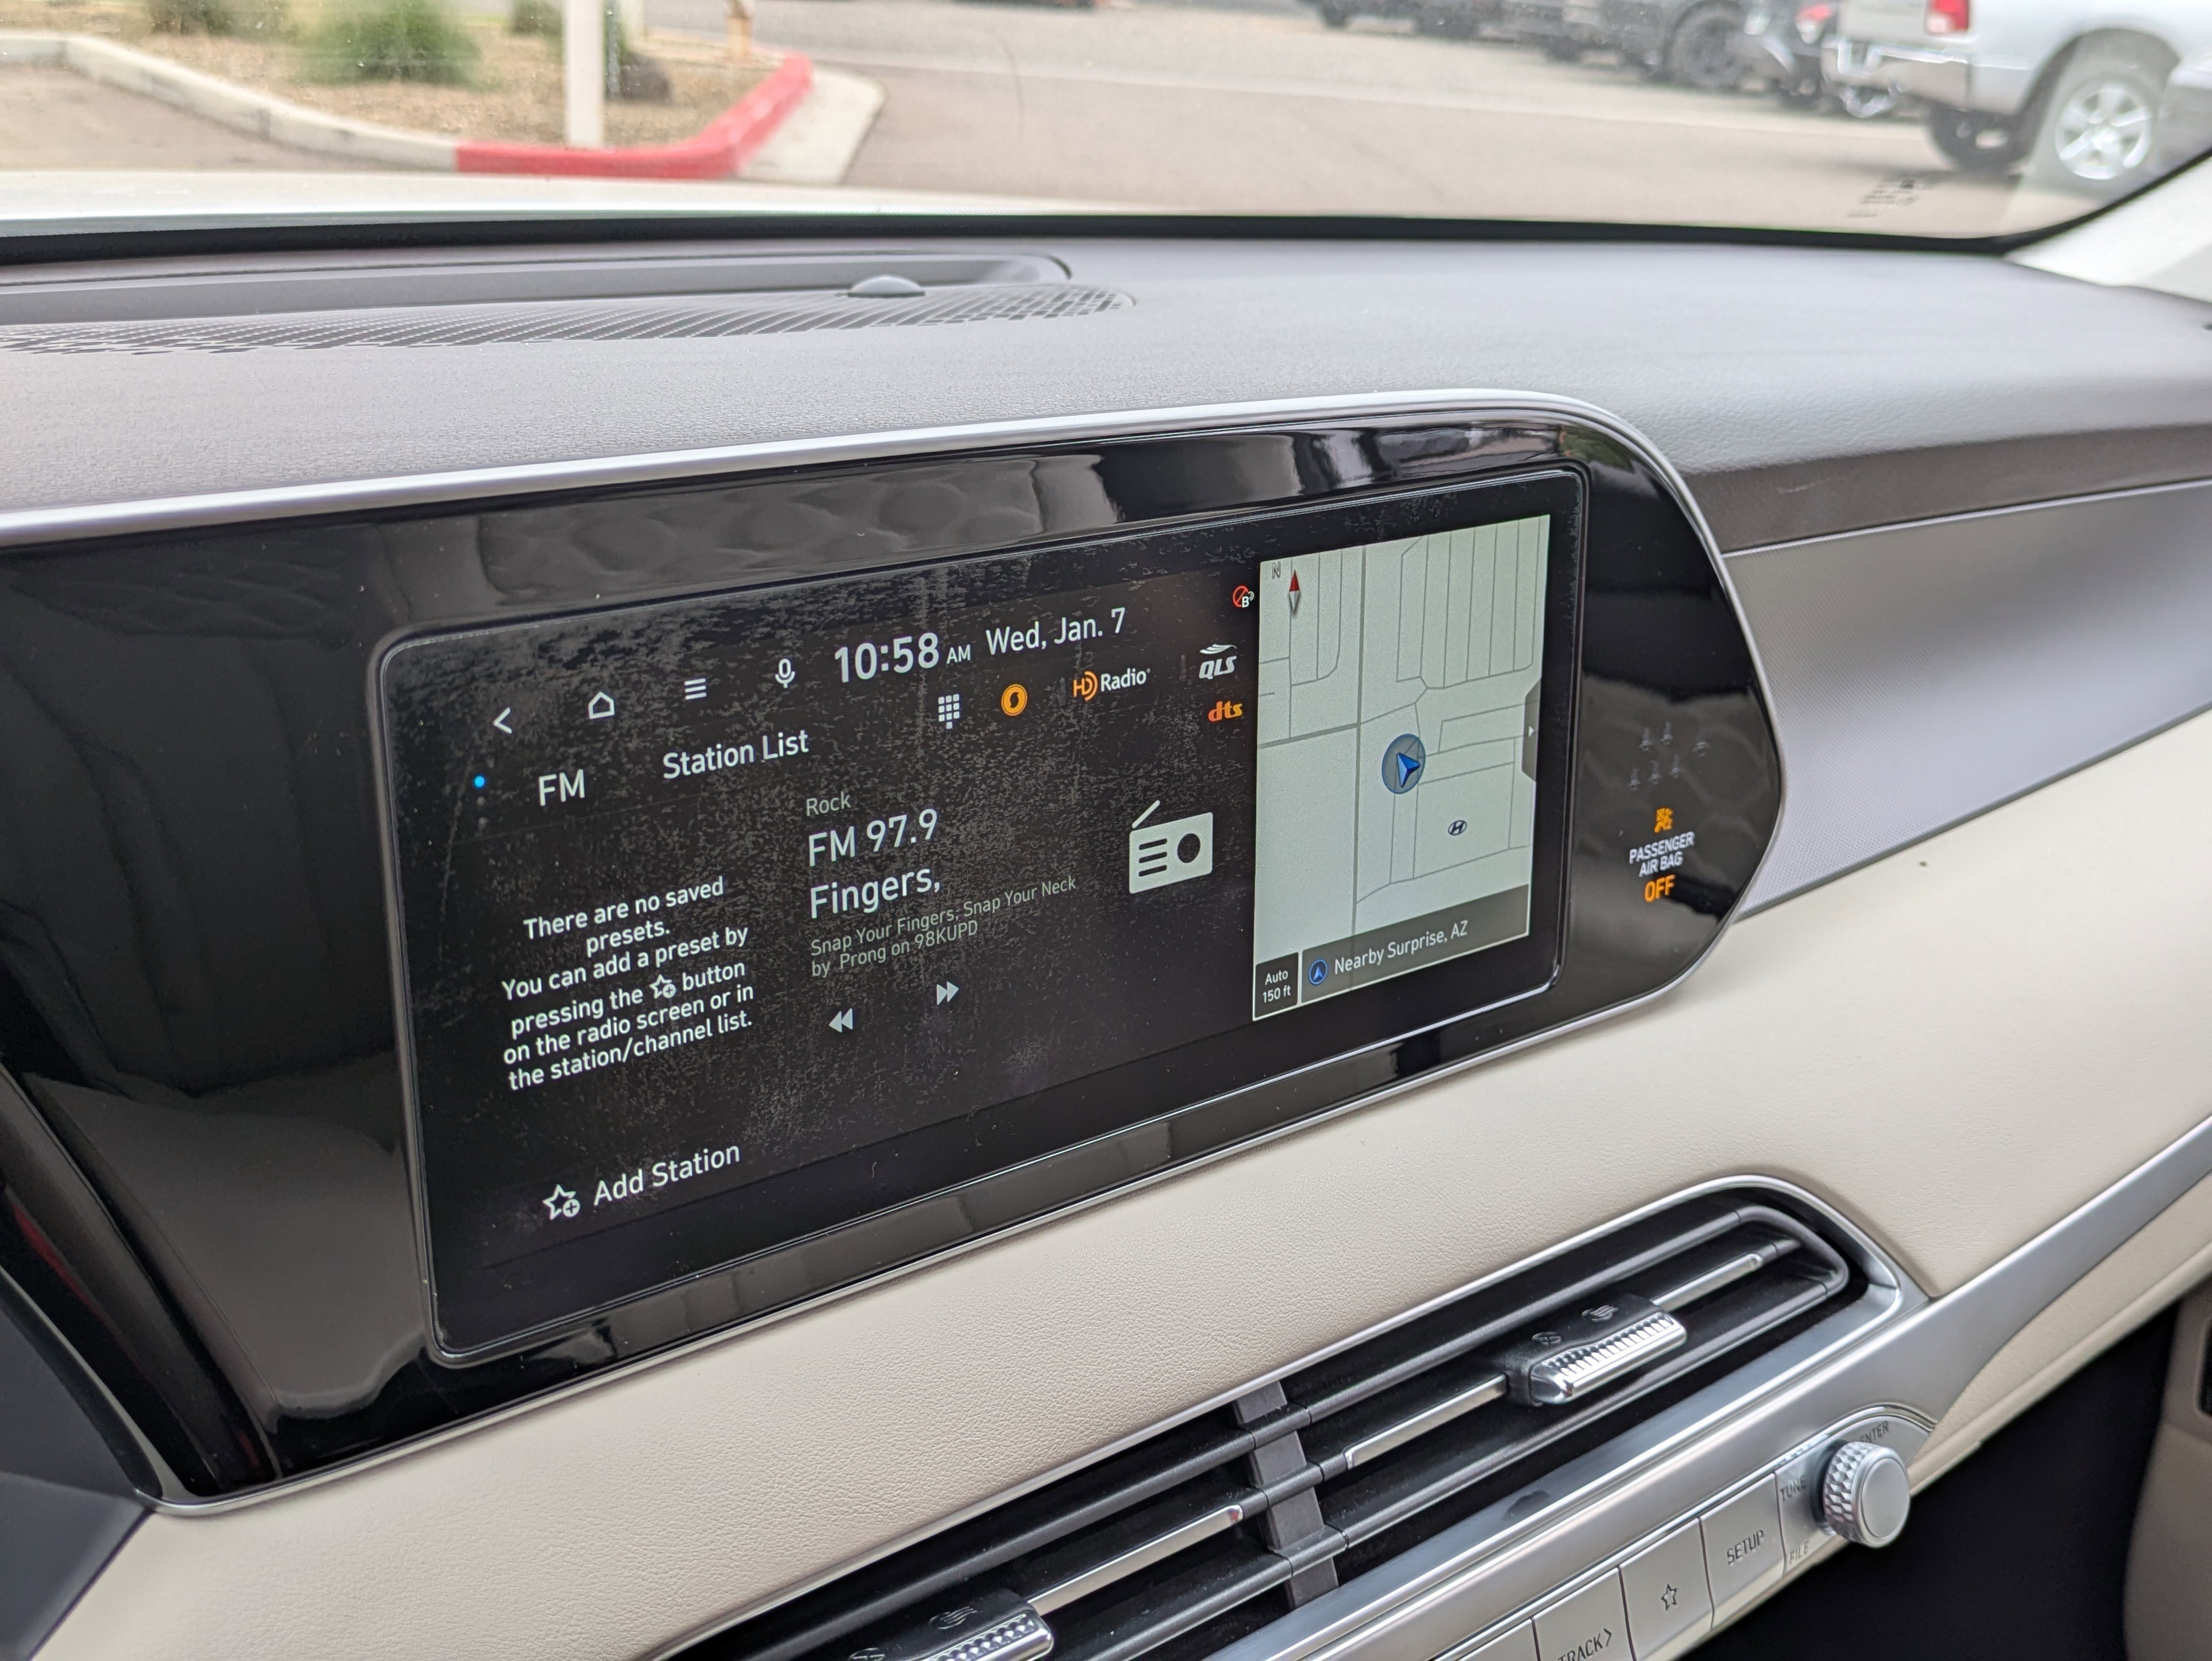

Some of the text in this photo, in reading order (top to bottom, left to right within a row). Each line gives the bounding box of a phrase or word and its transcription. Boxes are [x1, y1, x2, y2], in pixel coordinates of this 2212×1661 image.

[1272, 561, 1281, 579] N
[985, 607, 1126, 655] Wed, Jan. 7
[834, 632, 972, 683] 10:58 AM
[1199, 655, 1237, 679] QLS
[1101, 667, 1147, 692] Radio
[1208, 700, 1243, 721] dts
[663, 730, 809, 779] Station List
[538, 769, 585, 807] FM
[806, 791, 852, 817] Rock
[808, 808, 938, 866] FM 97.9
[1629, 831, 1695, 864] PASSENGER
[1639, 851, 1683, 878] AIR BAG
[810, 868, 941, 919] Fingers,
[1645, 874, 1676, 903] OFF
[524, 876, 724, 940] There are no saved
[811, 934, 852, 956] Snap
[856, 924, 892, 945] Your
[963, 897, 1001, 917] Snap
[1004, 886, 1037, 906] Your
[1042, 875, 1076, 897] Neck
[586, 919, 671, 957] presets.
[812, 920, 978, 977] by Prong on 98KUPD
[1334, 919, 1468, 974] Nearby Surprise, AZ
[501, 927, 748, 1000] You can add a preset by
[1265, 969, 1288, 986] Auto
[511, 962, 745, 1040] pressing the button
[1262, 985, 1291, 1003] 150 ft
[504, 984, 754, 1065] on the radio screen or in
[509, 1010, 752, 1091] the station/channel list.
[594, 1145, 741, 1206] Add Station
[1780, 1476, 1807, 1501] TUNE
[1726, 1529, 1764, 1565] SETUP
[1789, 1540, 1809, 1564] FILE
